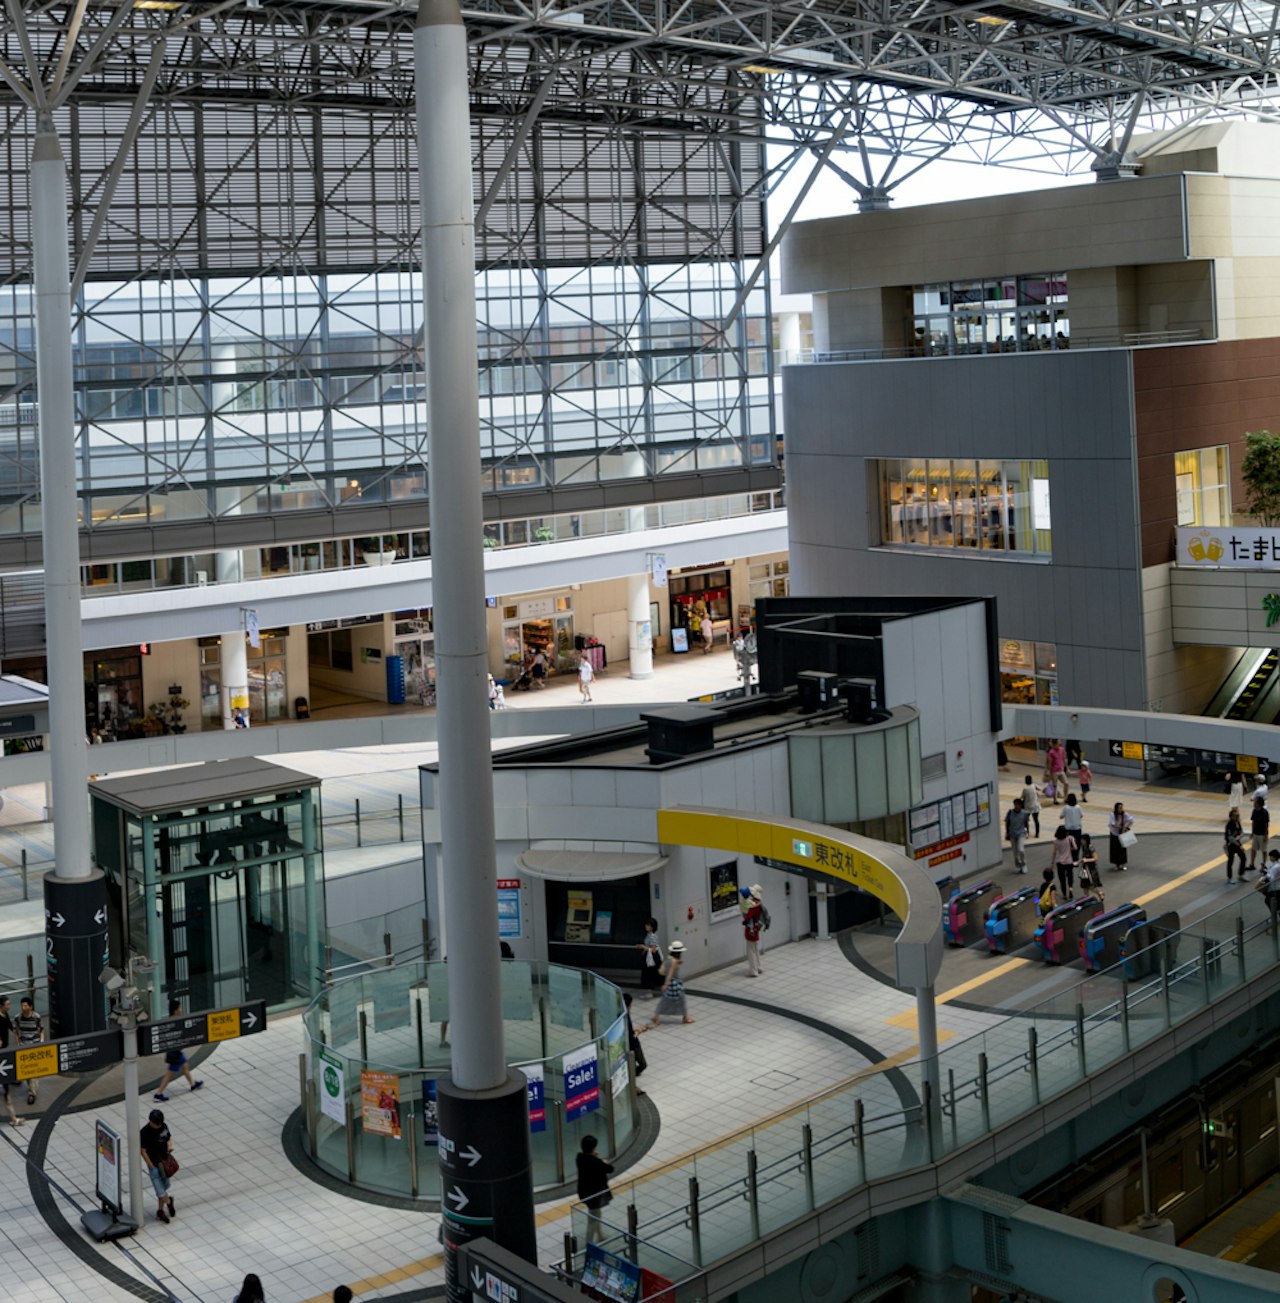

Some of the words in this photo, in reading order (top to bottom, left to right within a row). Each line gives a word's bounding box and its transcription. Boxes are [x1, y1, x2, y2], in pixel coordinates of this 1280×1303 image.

[814, 842, 858, 877] 東改札
[19, 1048, 54, 1063] 中央改札
[568, 1066, 595, 1089] Sale!
